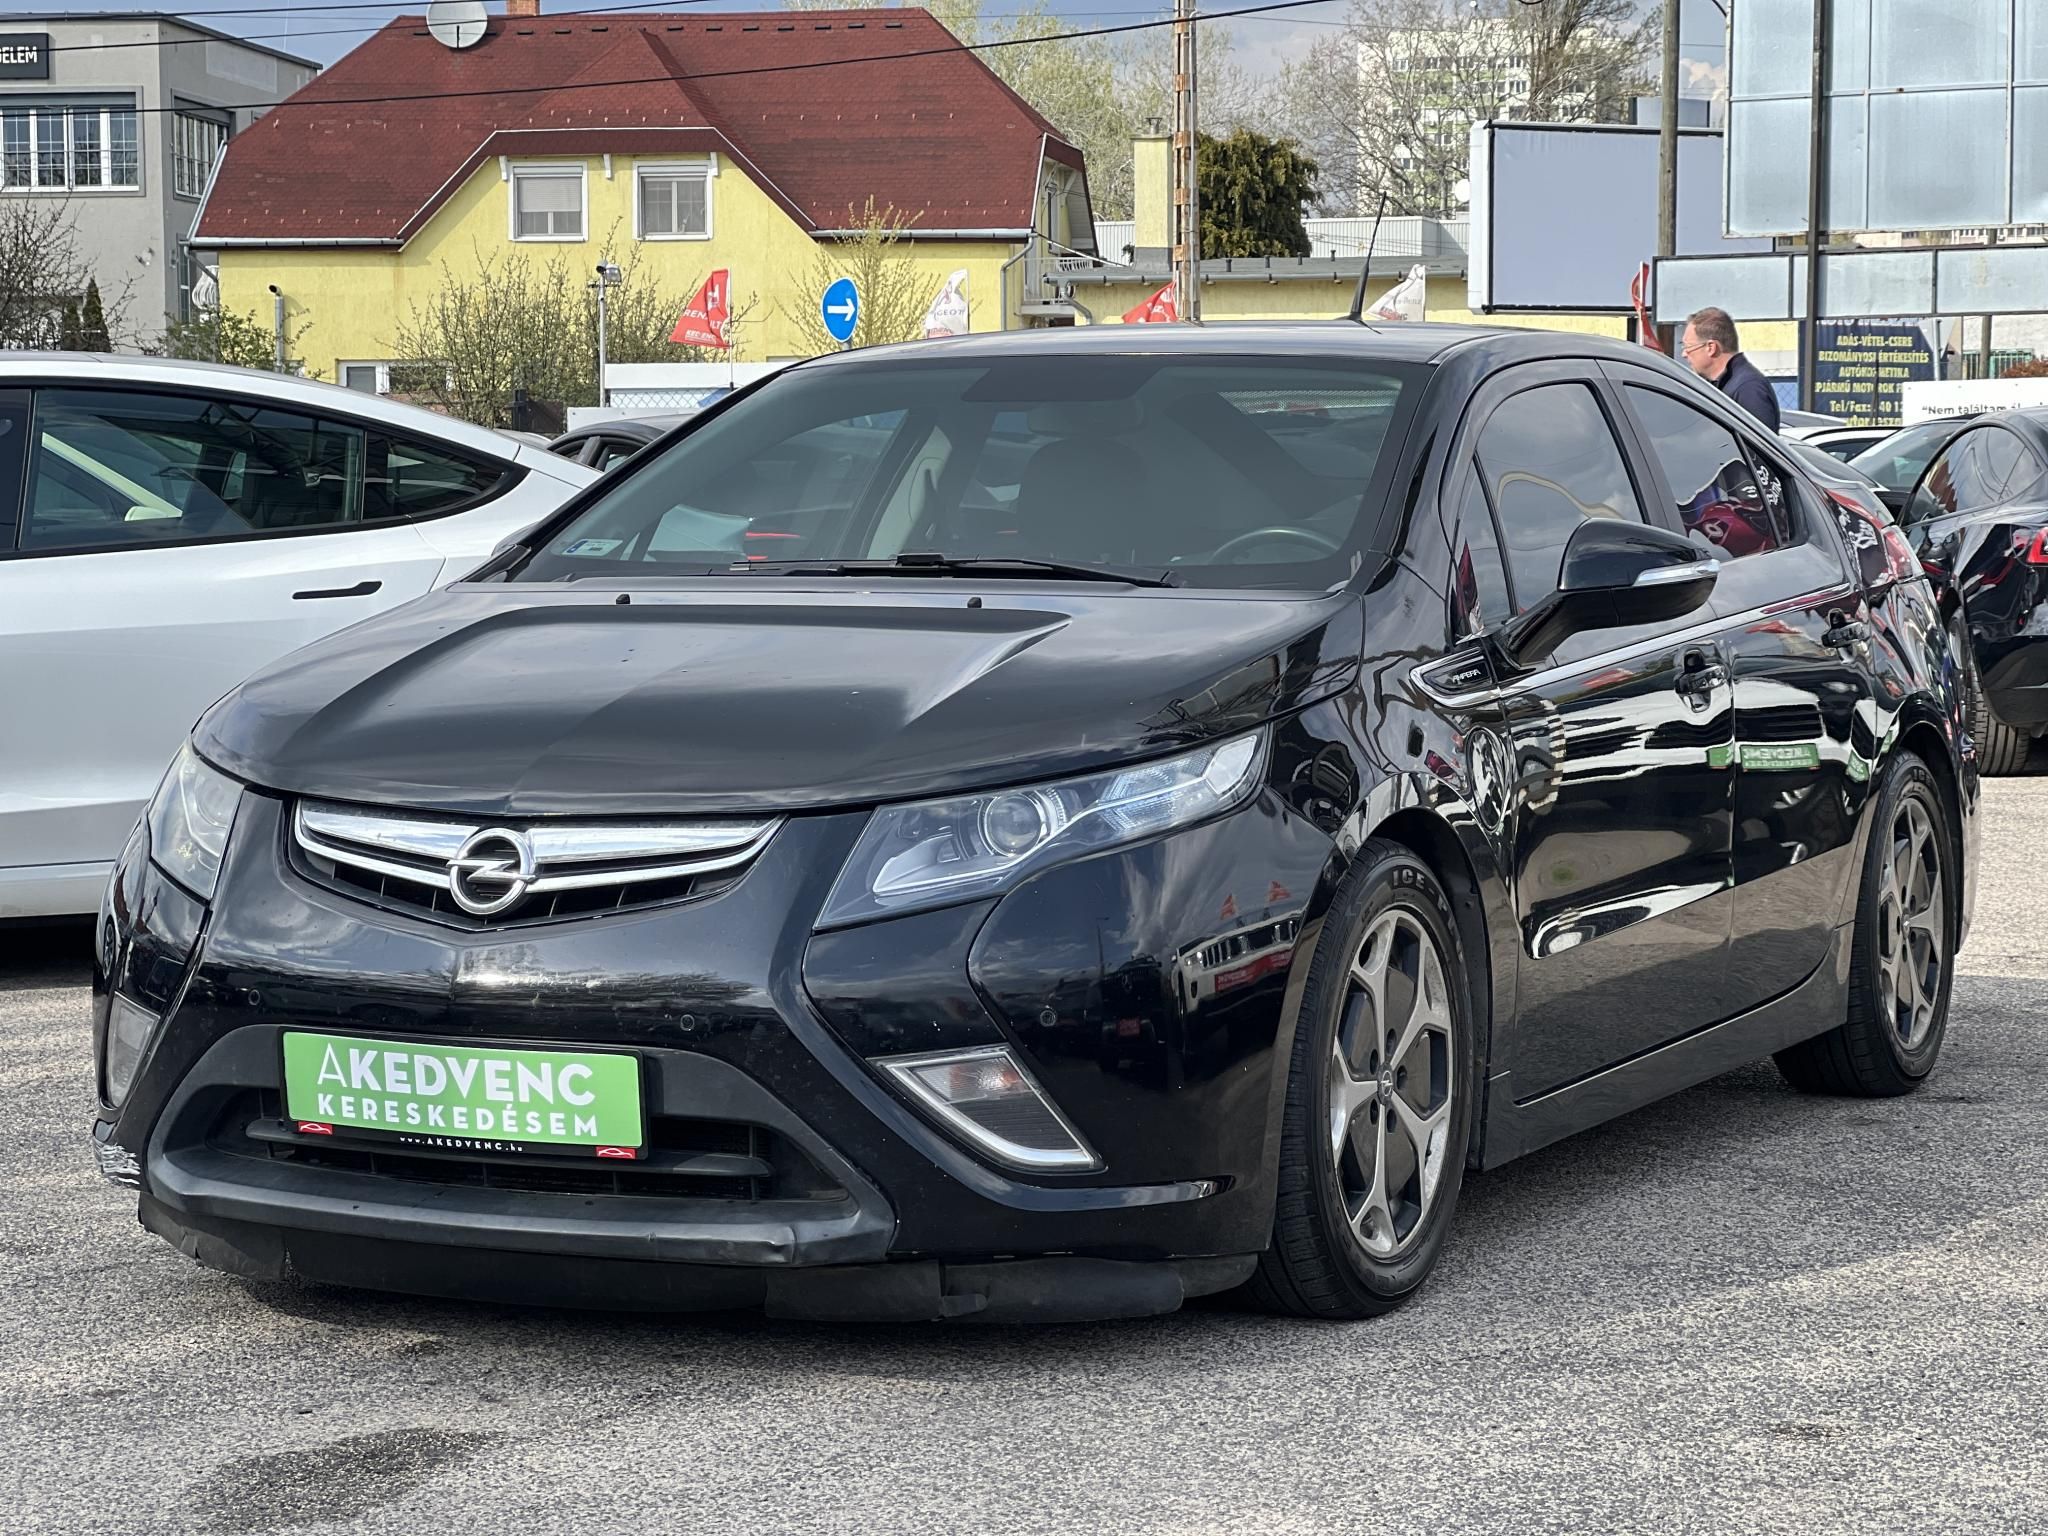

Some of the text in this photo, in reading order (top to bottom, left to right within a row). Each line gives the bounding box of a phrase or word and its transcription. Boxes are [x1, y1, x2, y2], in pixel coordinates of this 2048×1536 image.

[0, 46, 38, 64] ELEM
[1836, 333, 1912, 347] ADÁS-VÉTEL-CSERE
[1815, 380, 1850, 393] PJÁRMŰ
[317, 1042, 596, 1106] AKEDVENC
[317, 1093, 598, 1137] KERESKEDÉSEM
[400, 1137, 523, 1152] www.AKEDVENC.hu
